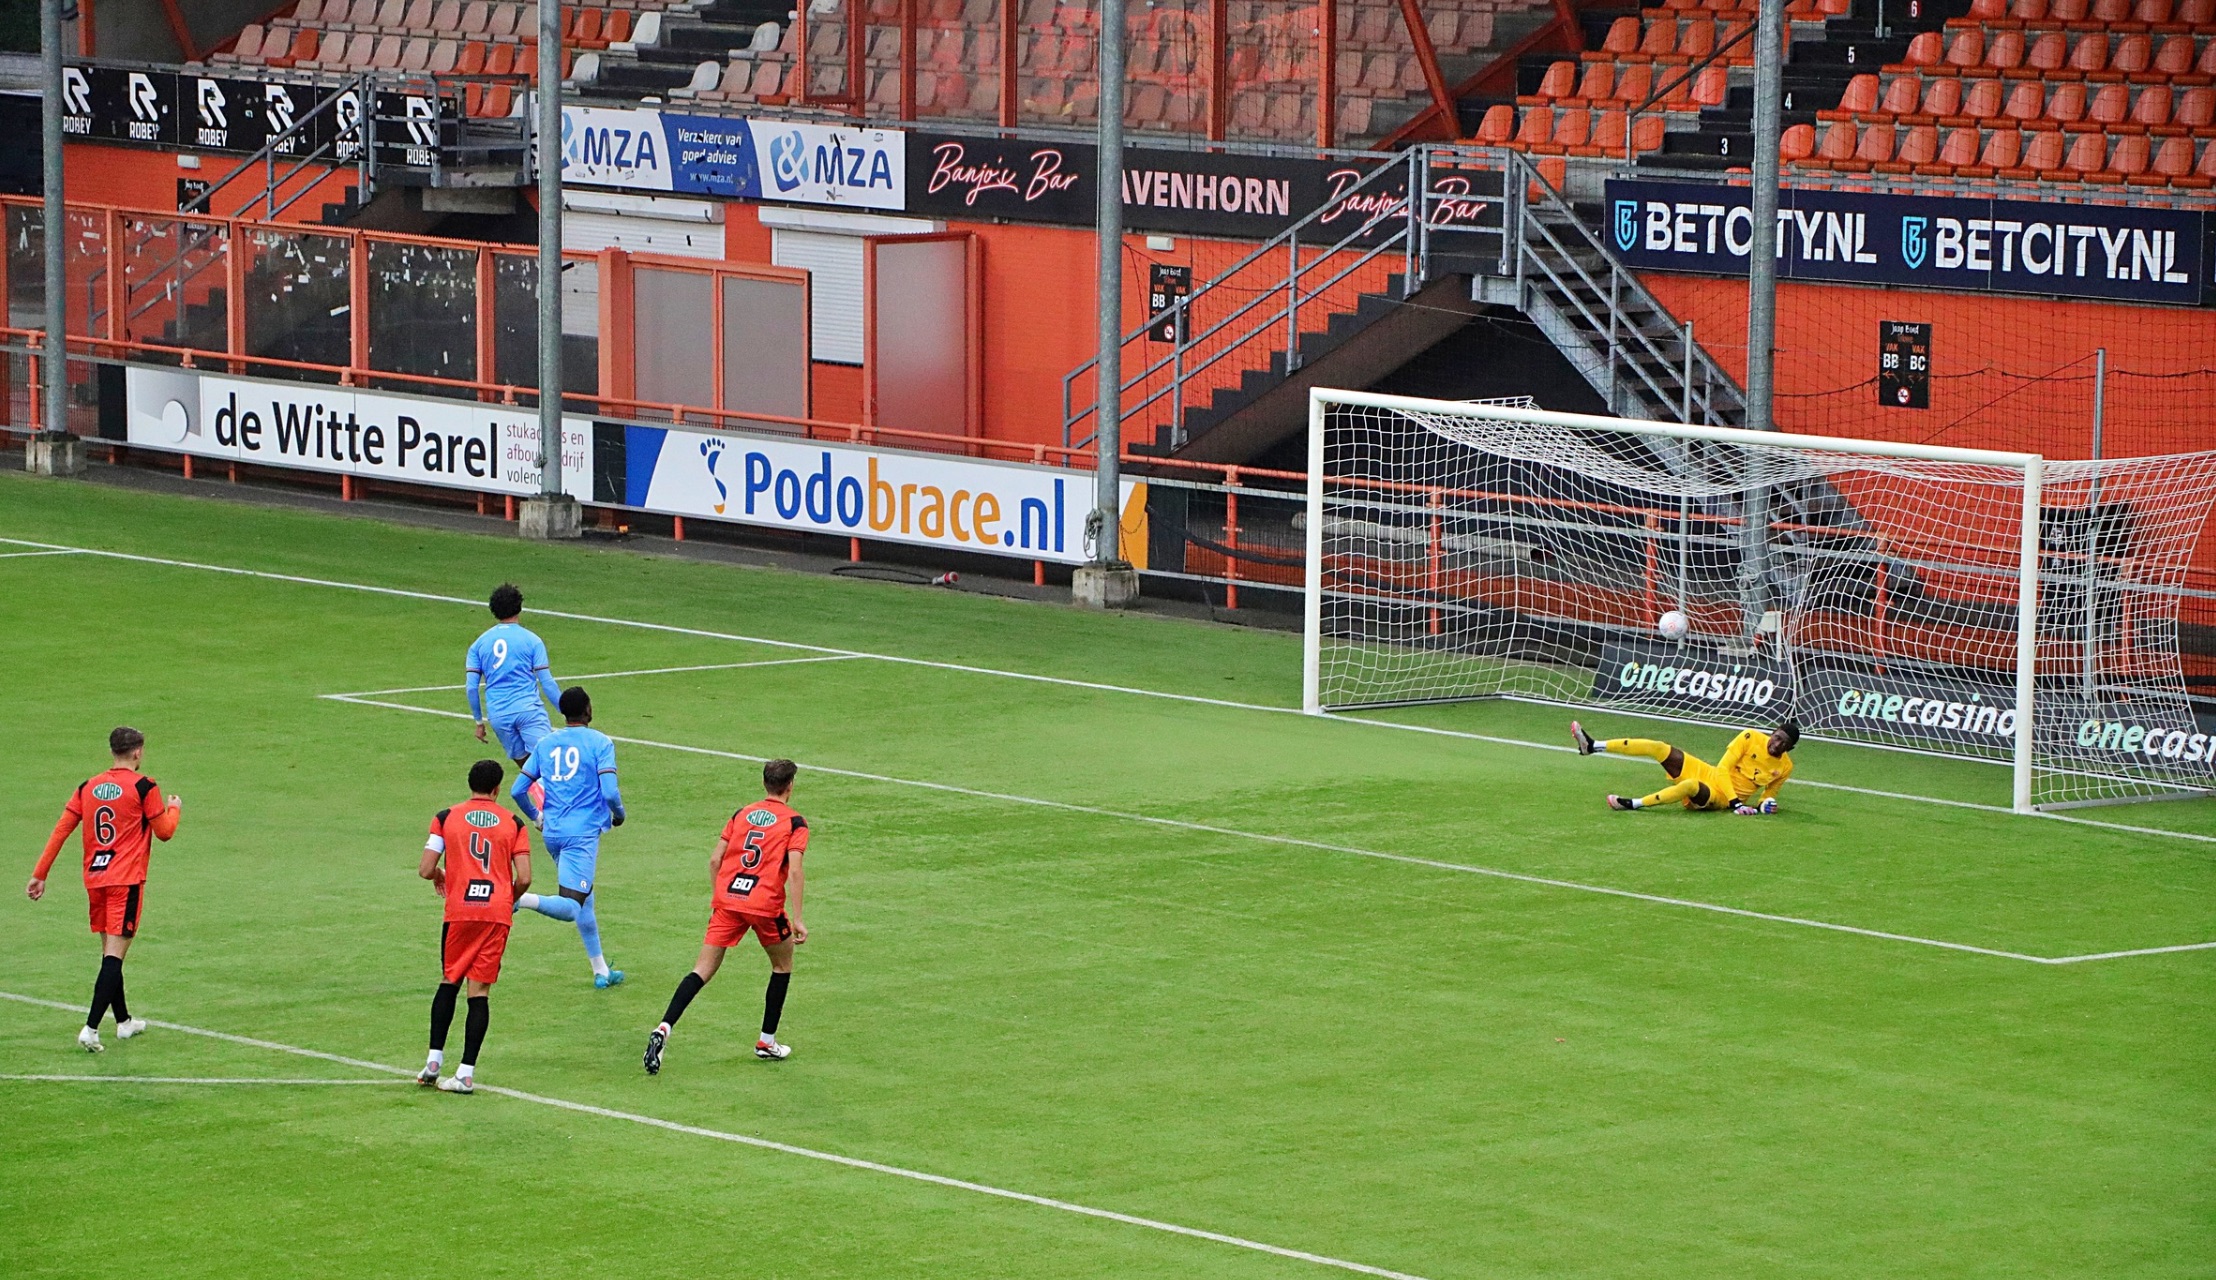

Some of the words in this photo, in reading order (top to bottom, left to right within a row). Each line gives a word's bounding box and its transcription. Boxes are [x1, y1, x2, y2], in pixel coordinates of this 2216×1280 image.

[1910, 1, 1918, 17] 6
[1848, 46, 1855, 63] 5
[1784, 93, 1792, 110] 4
[63, 116, 92, 135] ROBEY
[129, 121, 158, 140] ROBEY
[198, 128, 227, 147] ROBEY
[336, 140, 360, 158] ROB
[583, 127, 657, 170] MZA
[725, 135, 742, 146] van
[1721, 138, 1728, 155] 3
[706, 149, 737, 165] advies
[815, 145, 893, 190] MZA
[928, 143, 1019, 206] Banjo's
[1025, 149, 1078, 201] Bar
[1429, 175, 1487, 232] Bar
[1646, 201, 1877, 264] BETCTY.NL
[1935, 217, 2188, 283] BETCITY.NL
[1152, 293, 1165, 308] BB
[1883, 353, 1899, 369] BB
[1910, 355, 1926, 371] BC
[215, 392, 262, 450] de
[272, 402, 384, 465] Witte
[398, 415, 498, 478] Parel
[507, 422, 567, 444] stukas
[571, 432, 584, 446] en
[507, 443, 584, 472] afboudrijf
[507, 467, 541, 486] volen
[745, 452, 1064, 553] Podobrace.nl
[493, 638, 507, 670] 9
[1620, 654, 1773, 706] onecasino
[1838, 690, 2016, 736] onecasino
[549, 746, 580, 782] 19
[94, 805, 117, 846] 6
[469, 831, 492, 875] 4
[740, 829, 765, 870] 5
[468, 884, 491, 897] BD
[731, 877, 754, 891] BD
